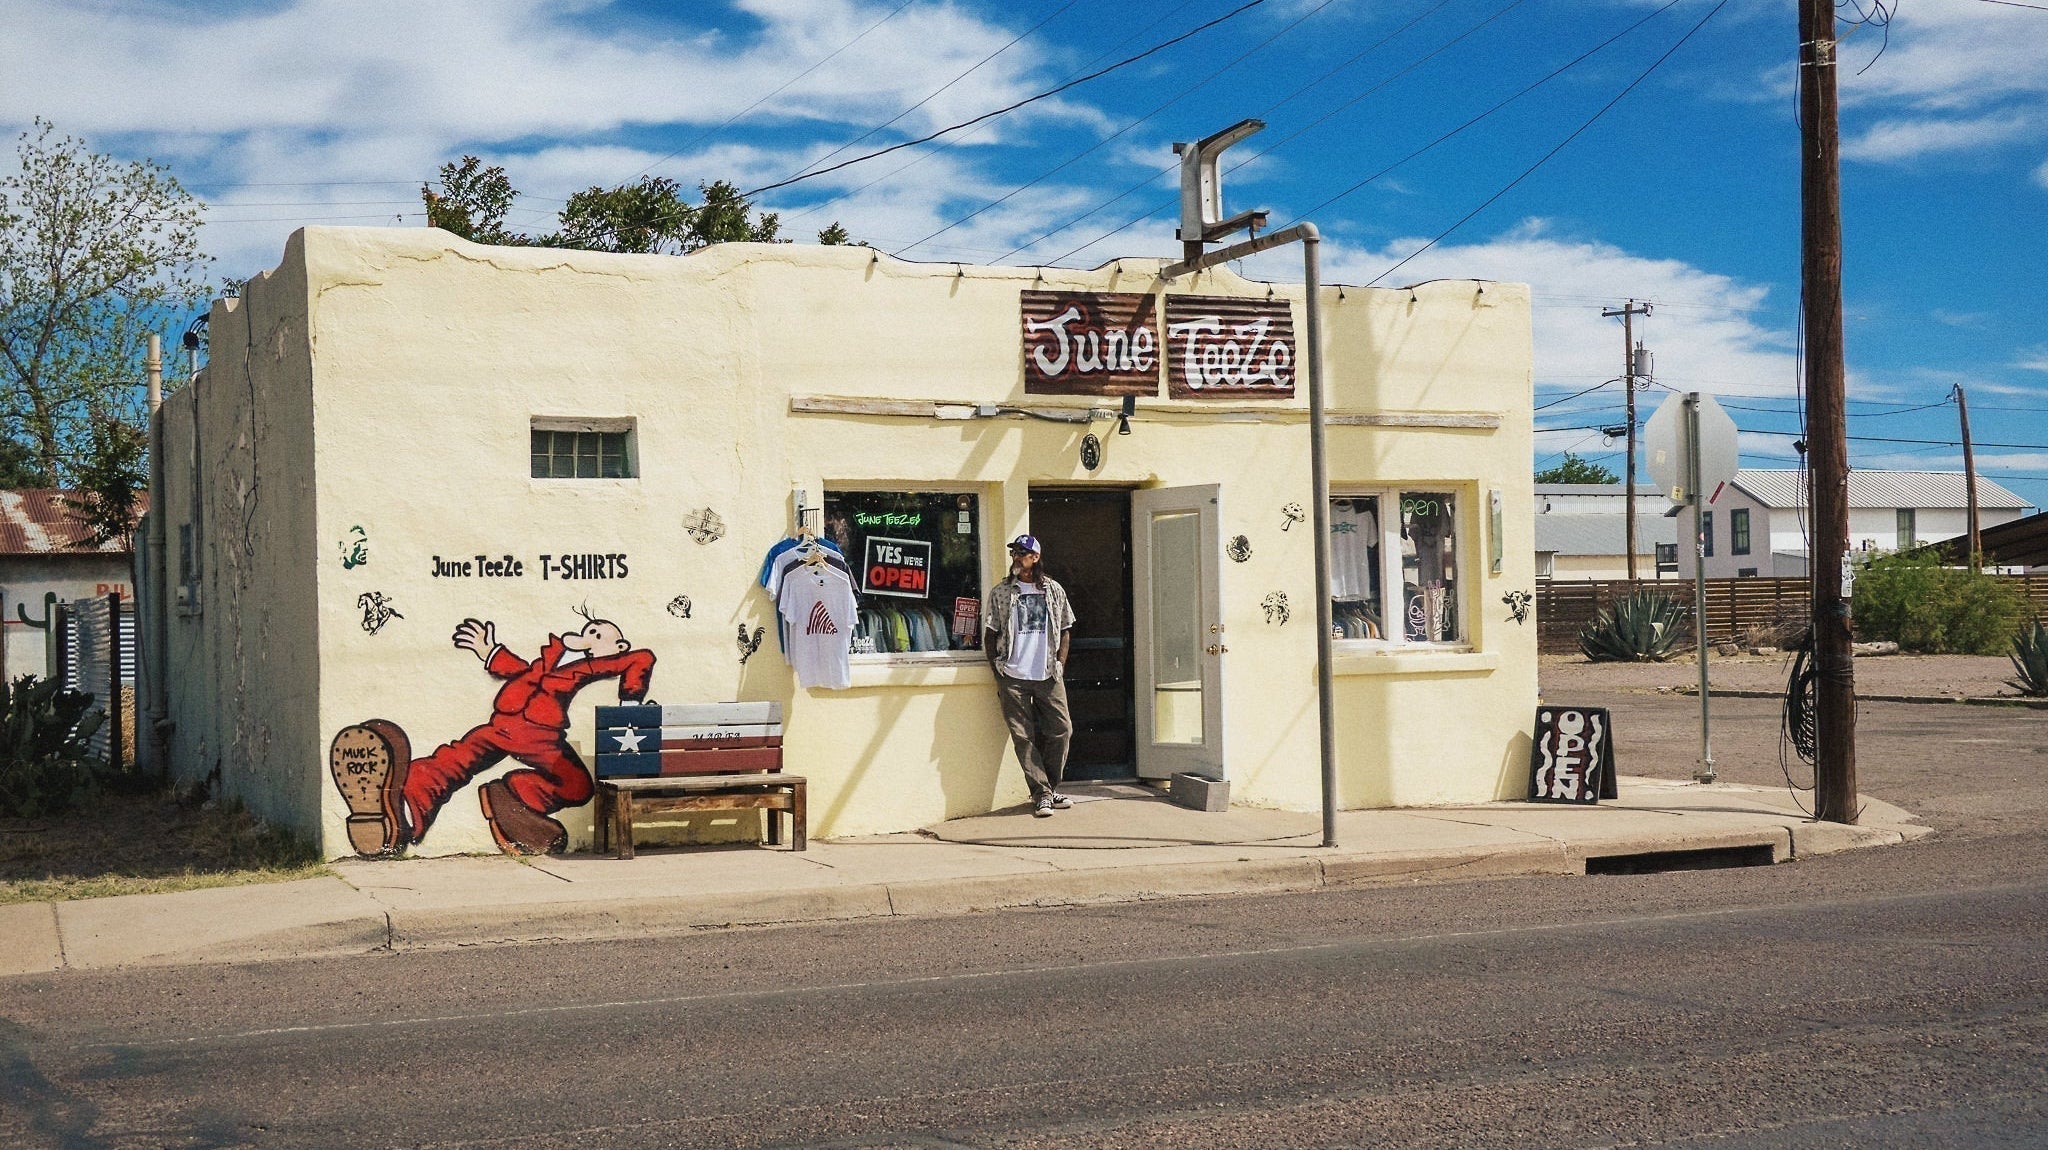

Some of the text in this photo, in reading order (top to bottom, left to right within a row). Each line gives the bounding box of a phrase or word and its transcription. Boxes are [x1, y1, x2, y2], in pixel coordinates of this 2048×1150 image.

[1026, 306, 1291, 390] June TeeZe
[431, 553, 629, 580] June TeeZe T-SHIRTS
[876, 544, 924, 567] YES WE'RE
[869, 565, 926, 590] OPEN
[342, 746, 378, 760] MUCK
[1551, 710, 1585, 800] OPEN
[346, 761, 378, 776] ROCK
